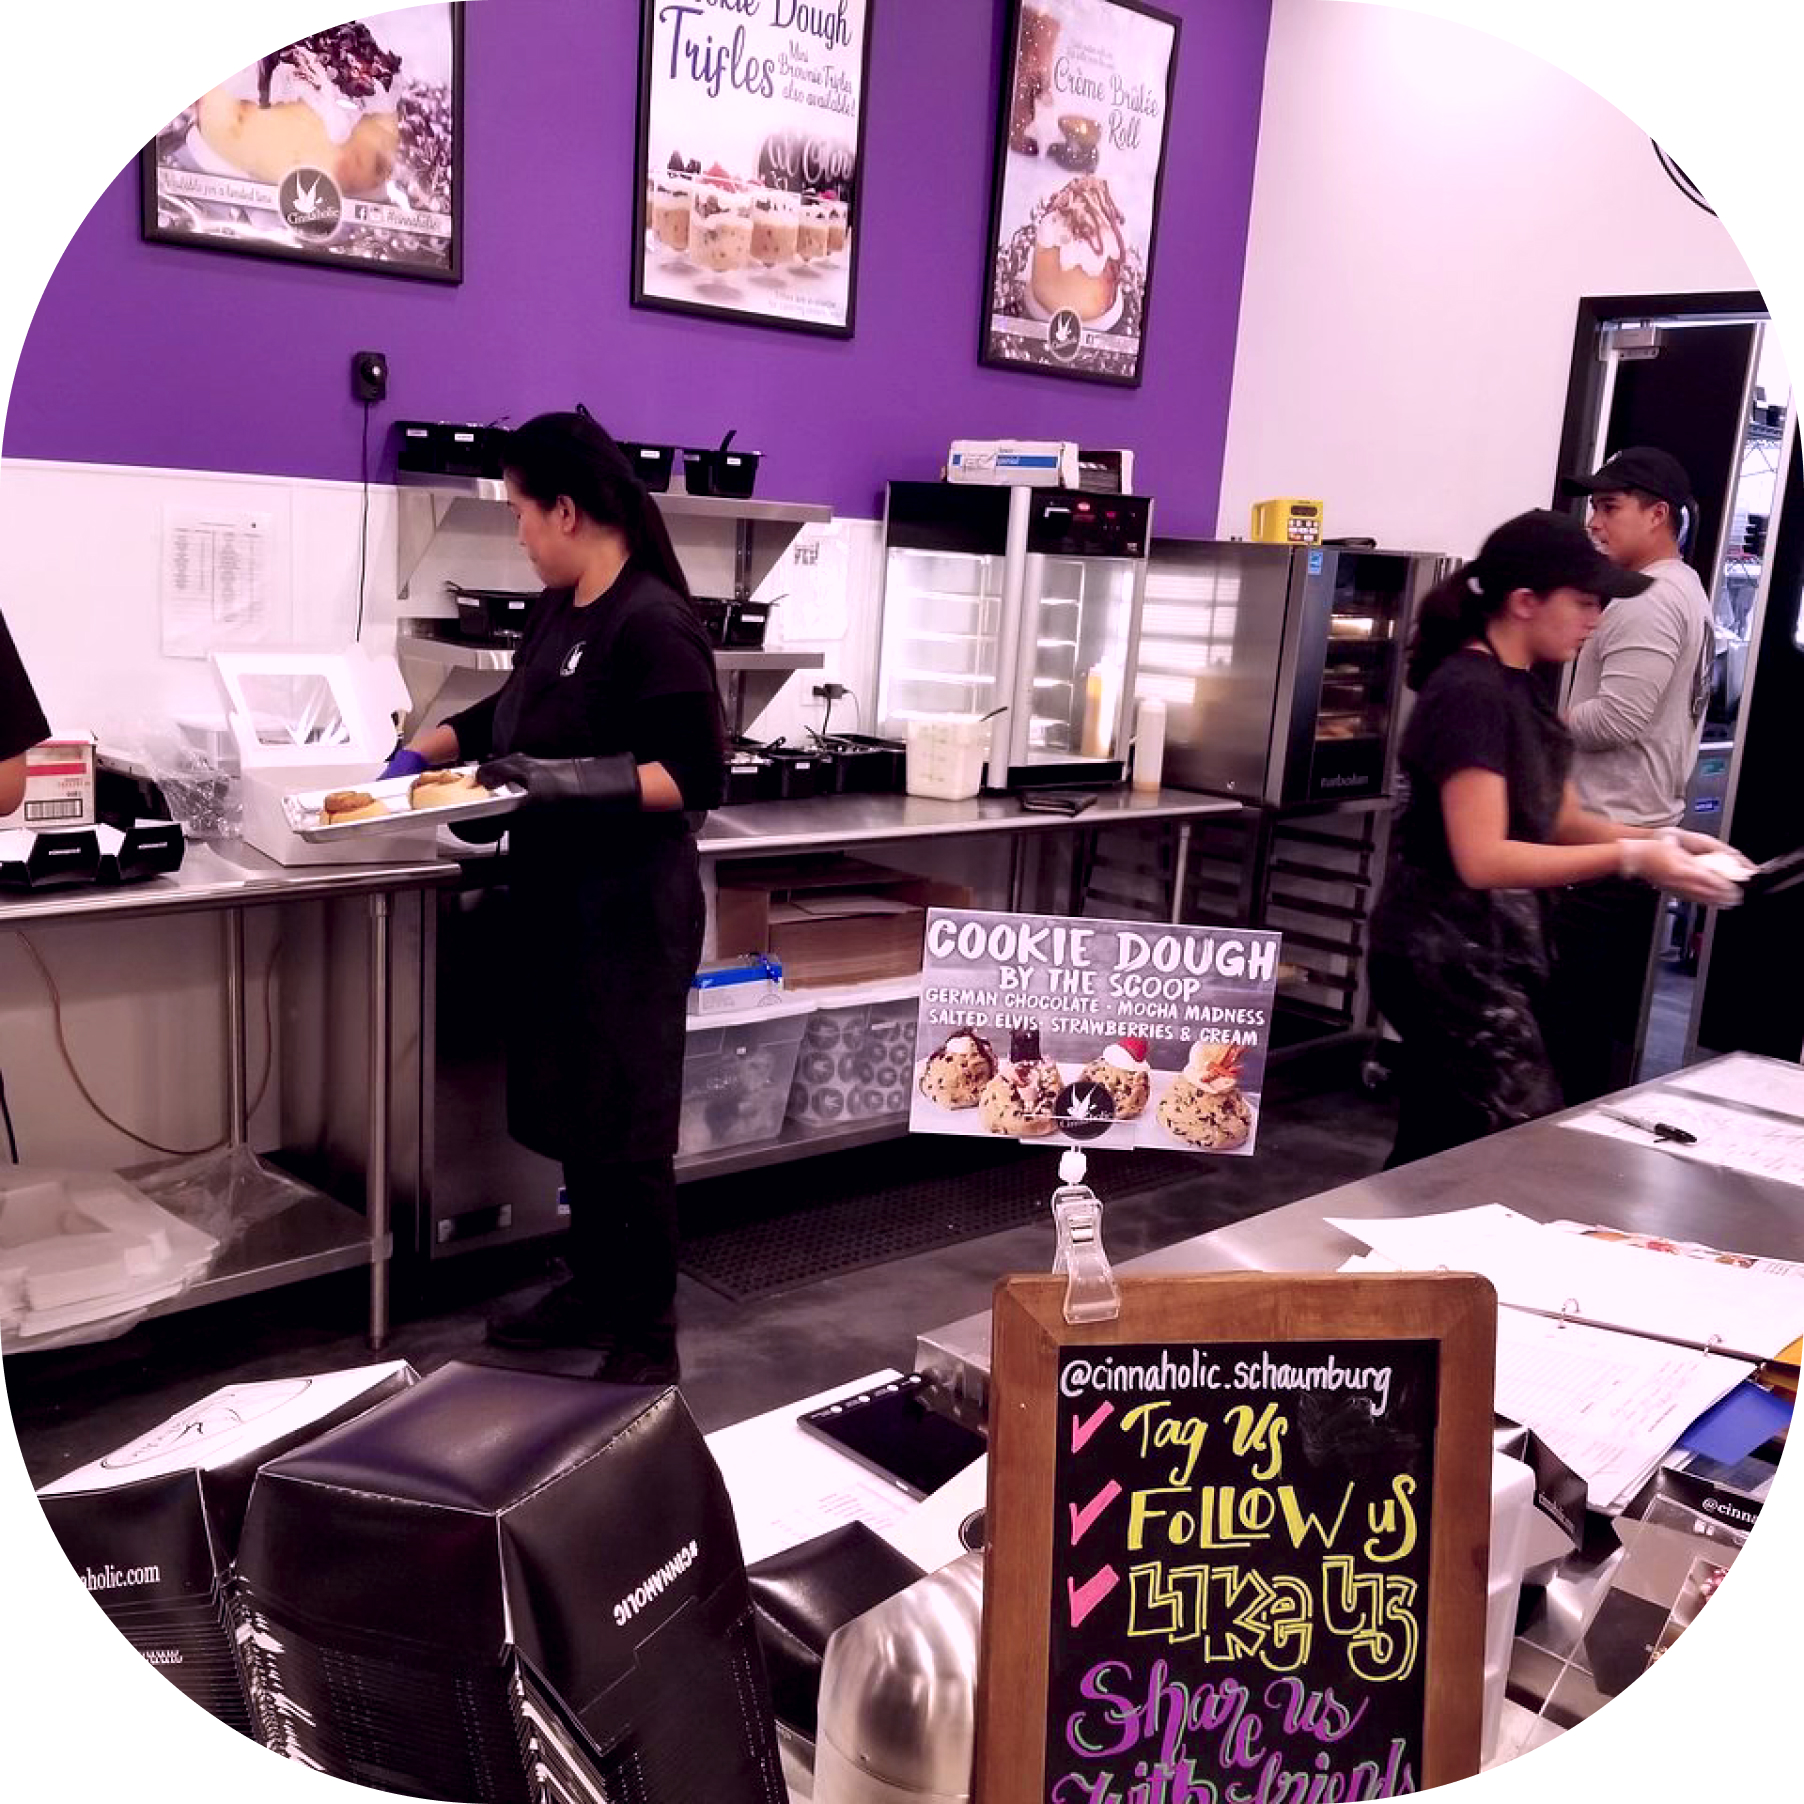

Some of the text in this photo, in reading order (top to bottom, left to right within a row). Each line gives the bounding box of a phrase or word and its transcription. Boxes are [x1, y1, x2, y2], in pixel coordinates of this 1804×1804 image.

[659, 5, 775, 98] Trifles
[768, 0, 852, 50] Dough
[1108, 109, 1141, 150] Roll
[928, 919, 1277, 981] COOKIE DOUGH
[926, 989, 1266, 1026] GERMAN CHOCOLATE MOCHA MADNESS
[999, 966, 1201, 1001] BY THE SCOOP
[929, 1009, 988, 1028] SALTED
[1051, 1017, 1174, 1041] STRAWBERRIES
[1180, 1026, 1191, 1042] &
[1200, 1026, 1258, 1046] CREAM
[1060, 1349, 1393, 1417] @cinnaholic.schaumburg
[1120, 1400, 1288, 1487] Tag Us
[613, 1539, 698, 1626] #CINNAHOLIC
[1066, 1658, 1370, 1769] Share us
